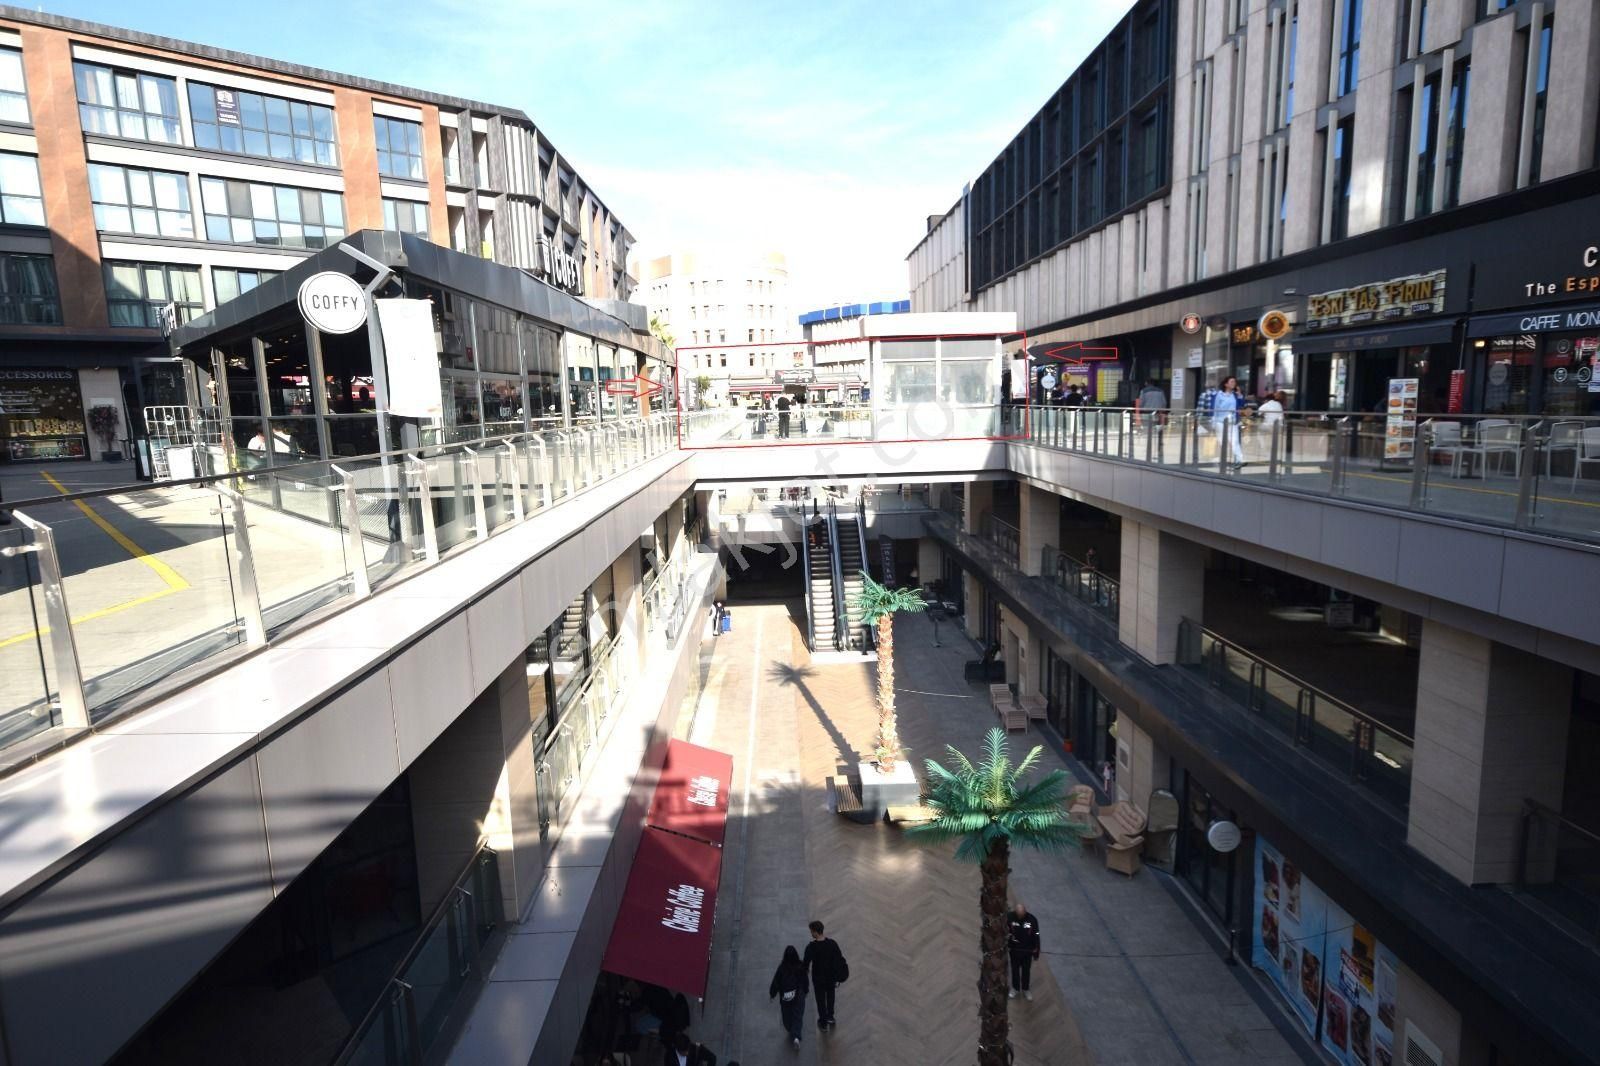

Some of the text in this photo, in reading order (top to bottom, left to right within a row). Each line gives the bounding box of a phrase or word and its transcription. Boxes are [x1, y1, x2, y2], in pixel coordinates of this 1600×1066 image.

[554, 245, 581, 294] COFFY
[1384, 279, 1432, 305] FIRIN
[1525, 276, 1600, 297] The Esp
[312, 294, 358, 311] COFFY
[1520, 314, 1560, 331] CAFFE
